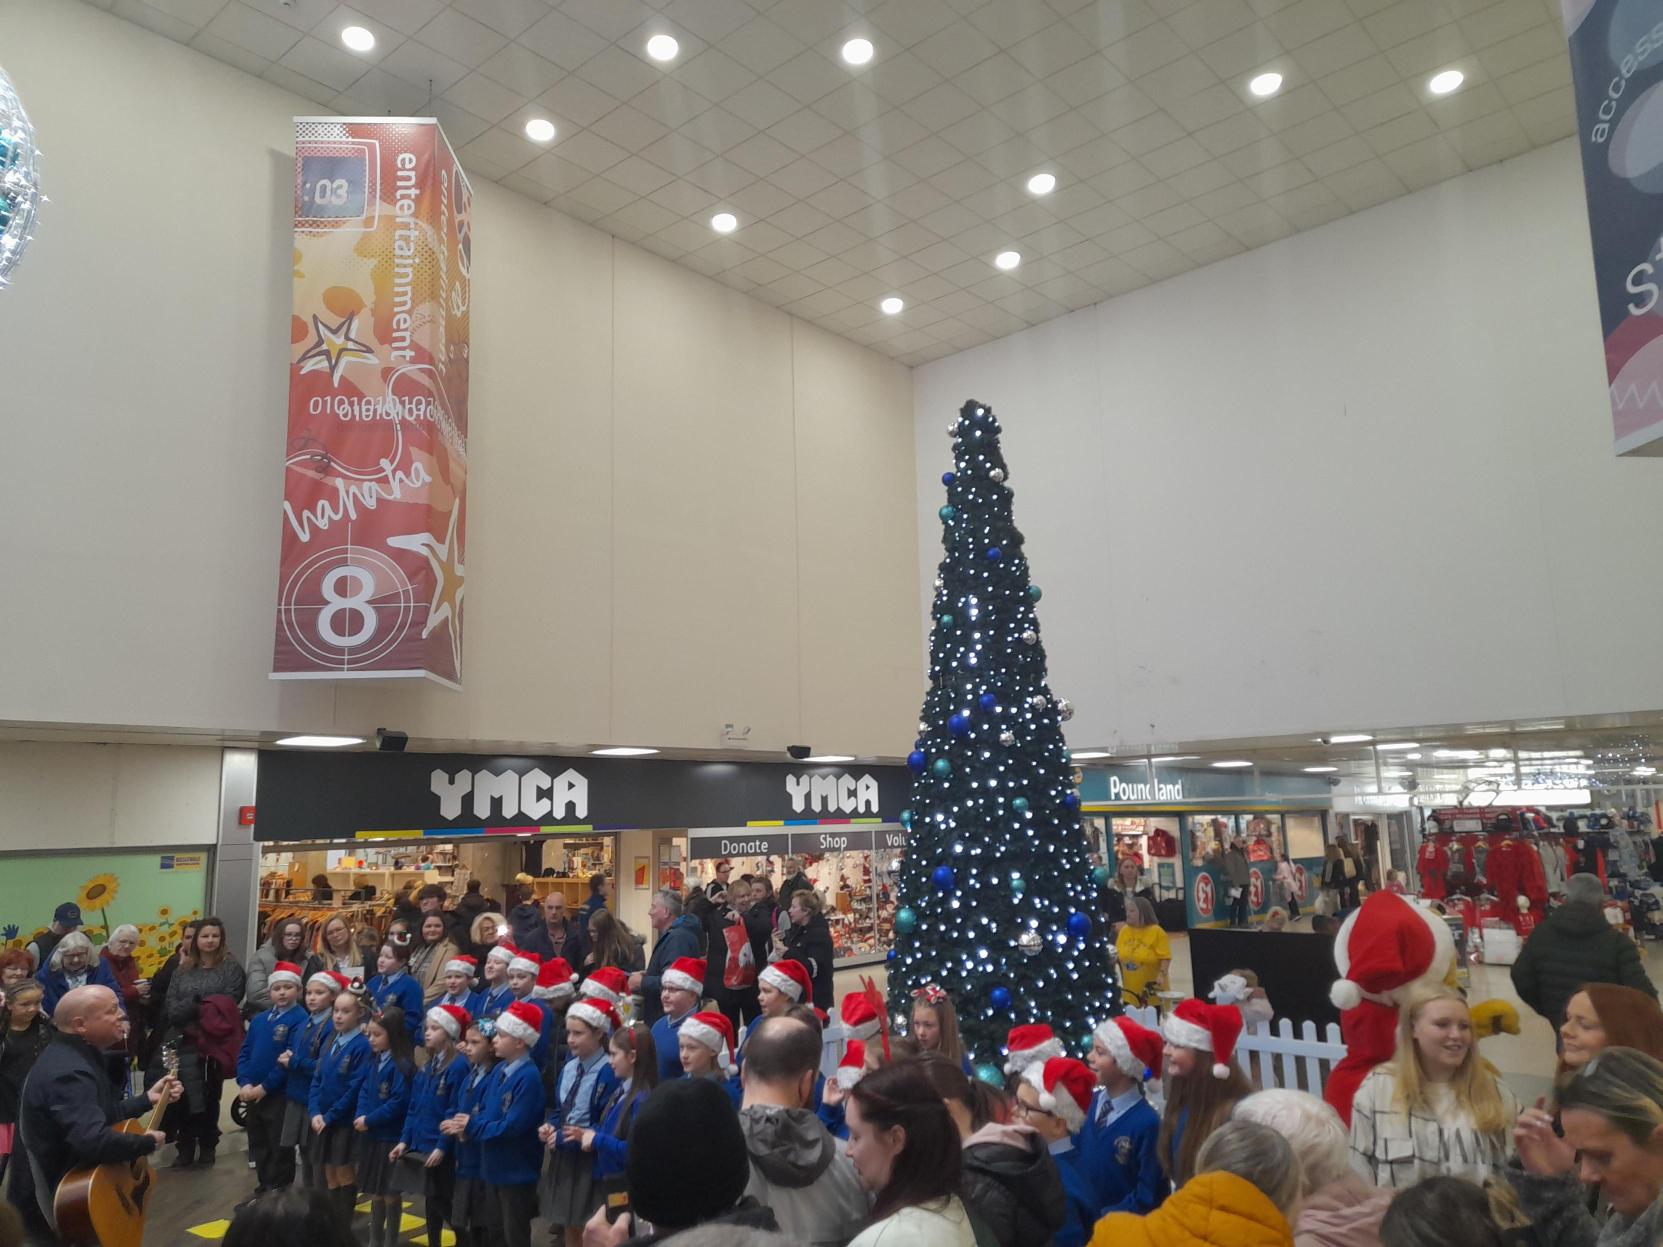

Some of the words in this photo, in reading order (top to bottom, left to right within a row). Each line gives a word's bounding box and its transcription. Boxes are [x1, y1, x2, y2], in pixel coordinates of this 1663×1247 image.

[391, 152, 420, 361] entertainment
[283, 457, 433, 543] hahaha
[317, 565, 378, 647] 8
[430, 767, 589, 821] YMCA
[785, 773, 879, 814] YMCA
[721, 840, 769, 855] Donate
[819, 834, 848, 850] Shop
[1198, 881, 1212, 911] £1
